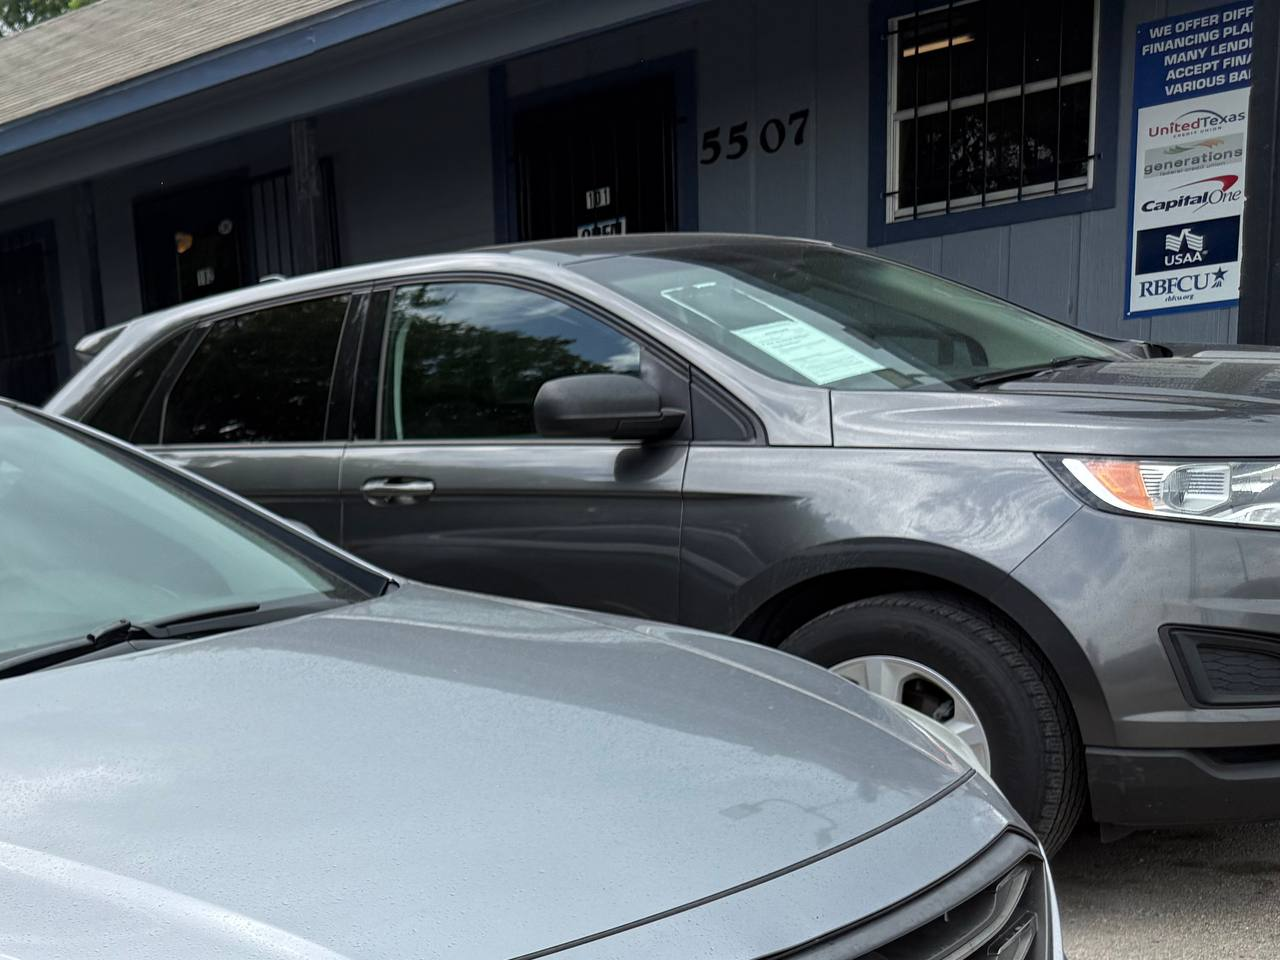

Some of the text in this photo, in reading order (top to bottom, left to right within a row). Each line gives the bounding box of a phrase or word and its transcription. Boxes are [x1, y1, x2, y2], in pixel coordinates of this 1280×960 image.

[1149, 25, 1172, 39] WE
[1175, 14, 1219, 33] OFFER
[1142, 29, 1219, 56] FINANCING
[1164, 47, 1208, 67] MANY
[1165, 69, 1251, 96] VARIOUS BA
[1166, 60, 1220, 81] ACCEPT
[700, 108, 810, 165] 5507
[1144, 148, 1243, 175] generations
[1164, 252, 1202, 267] USAA
[1139, 272, 1211, 298] RBFCU
